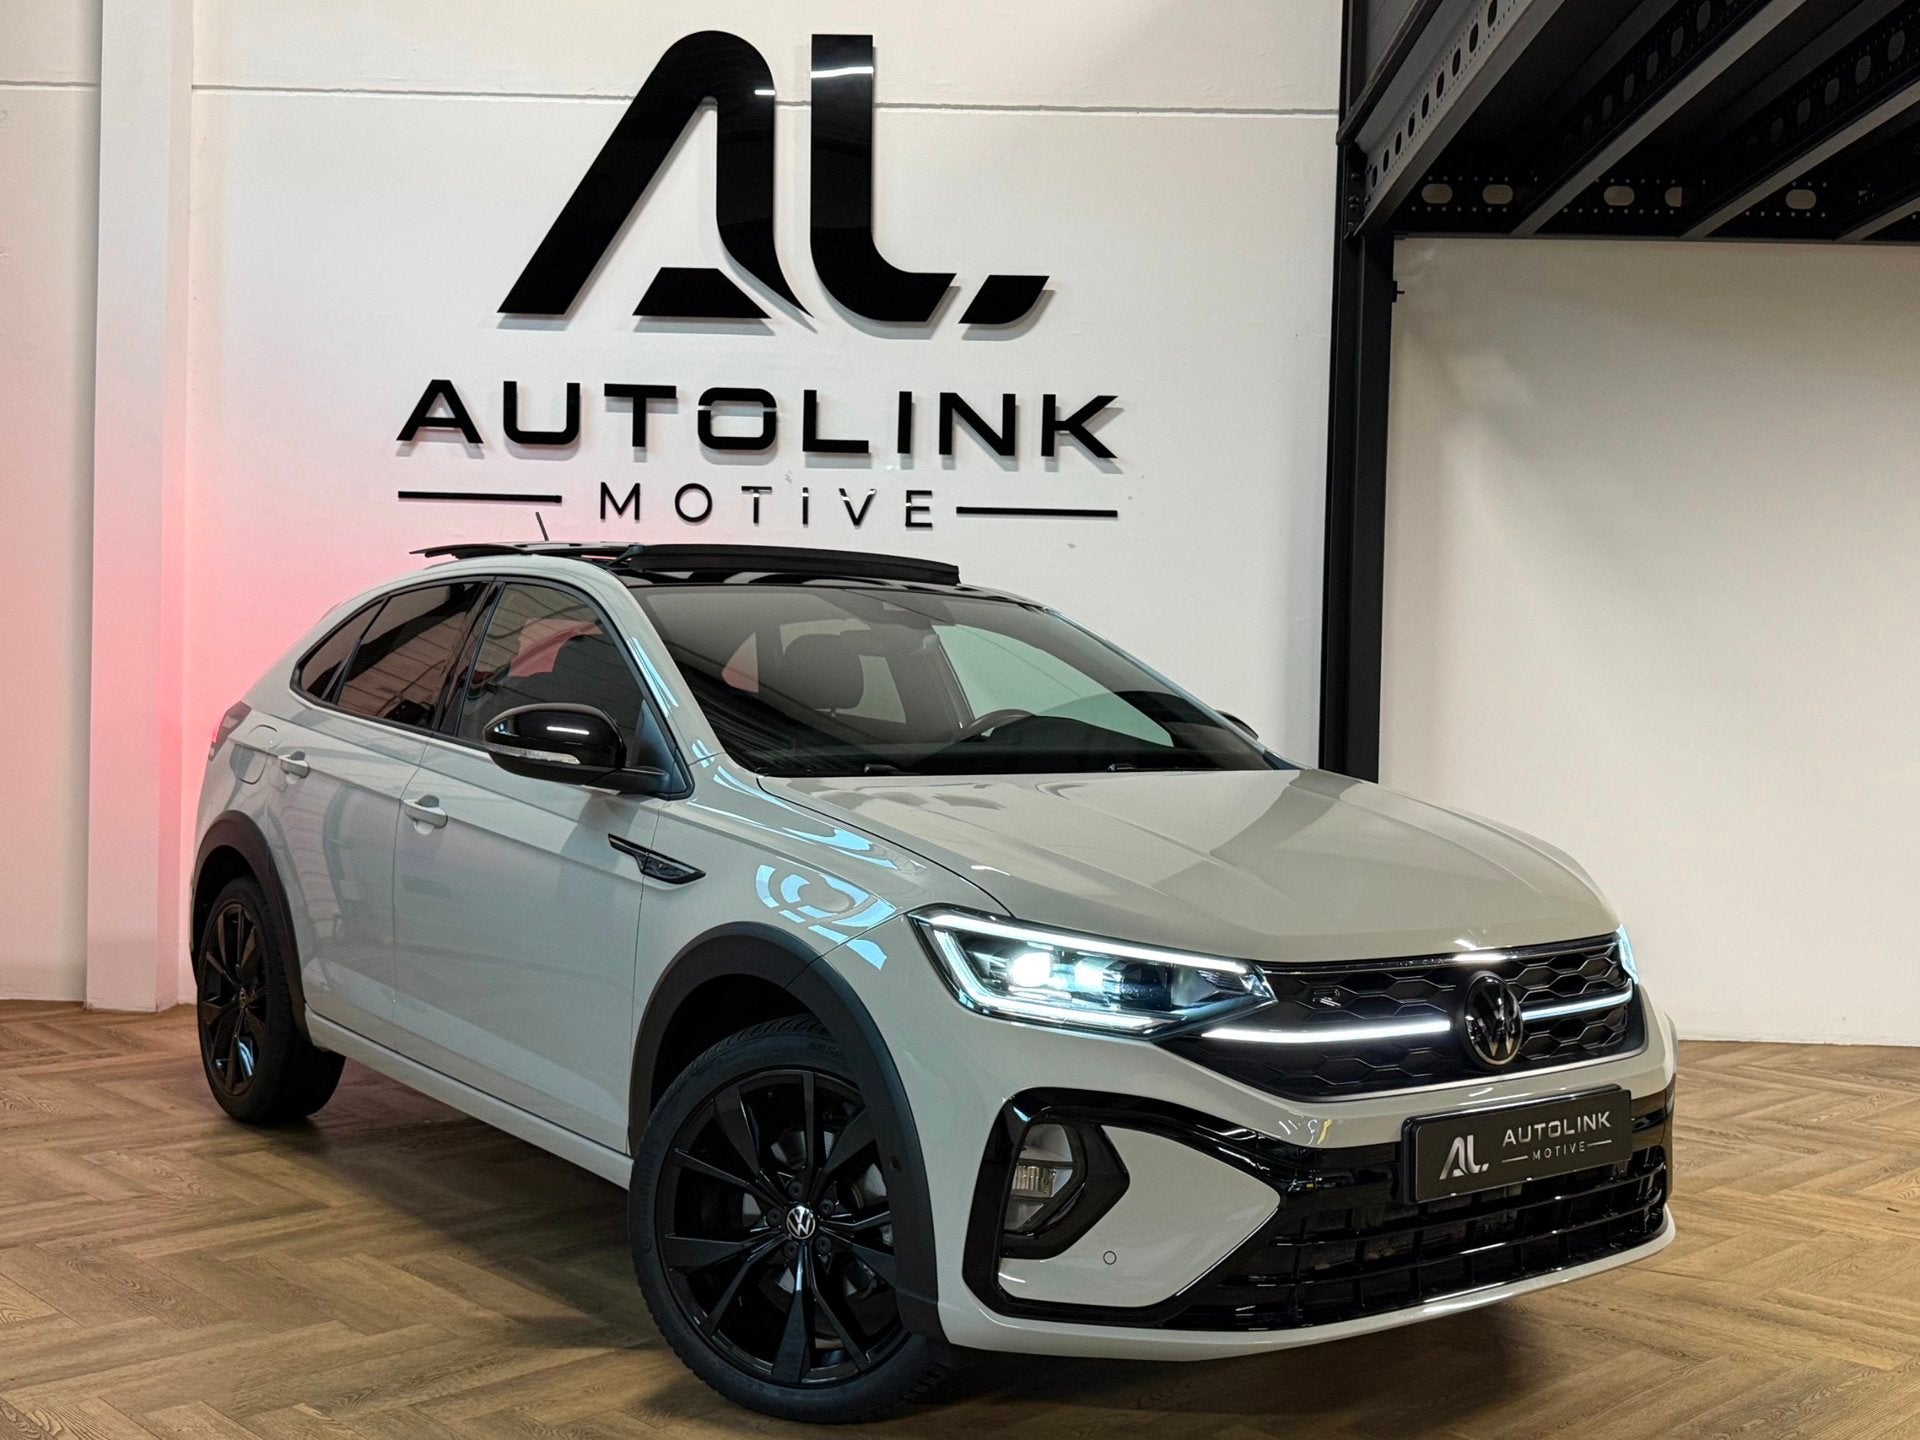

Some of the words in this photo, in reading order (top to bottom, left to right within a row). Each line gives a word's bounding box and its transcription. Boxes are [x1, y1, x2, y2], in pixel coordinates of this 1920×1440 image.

[396, 379, 1118, 459] AUTOLINK
[600, 481, 933, 528] MOTIVE
[1502, 1111, 1612, 1147] AUTOLINK
[1532, 1141, 1586, 1161] MOTIVE
